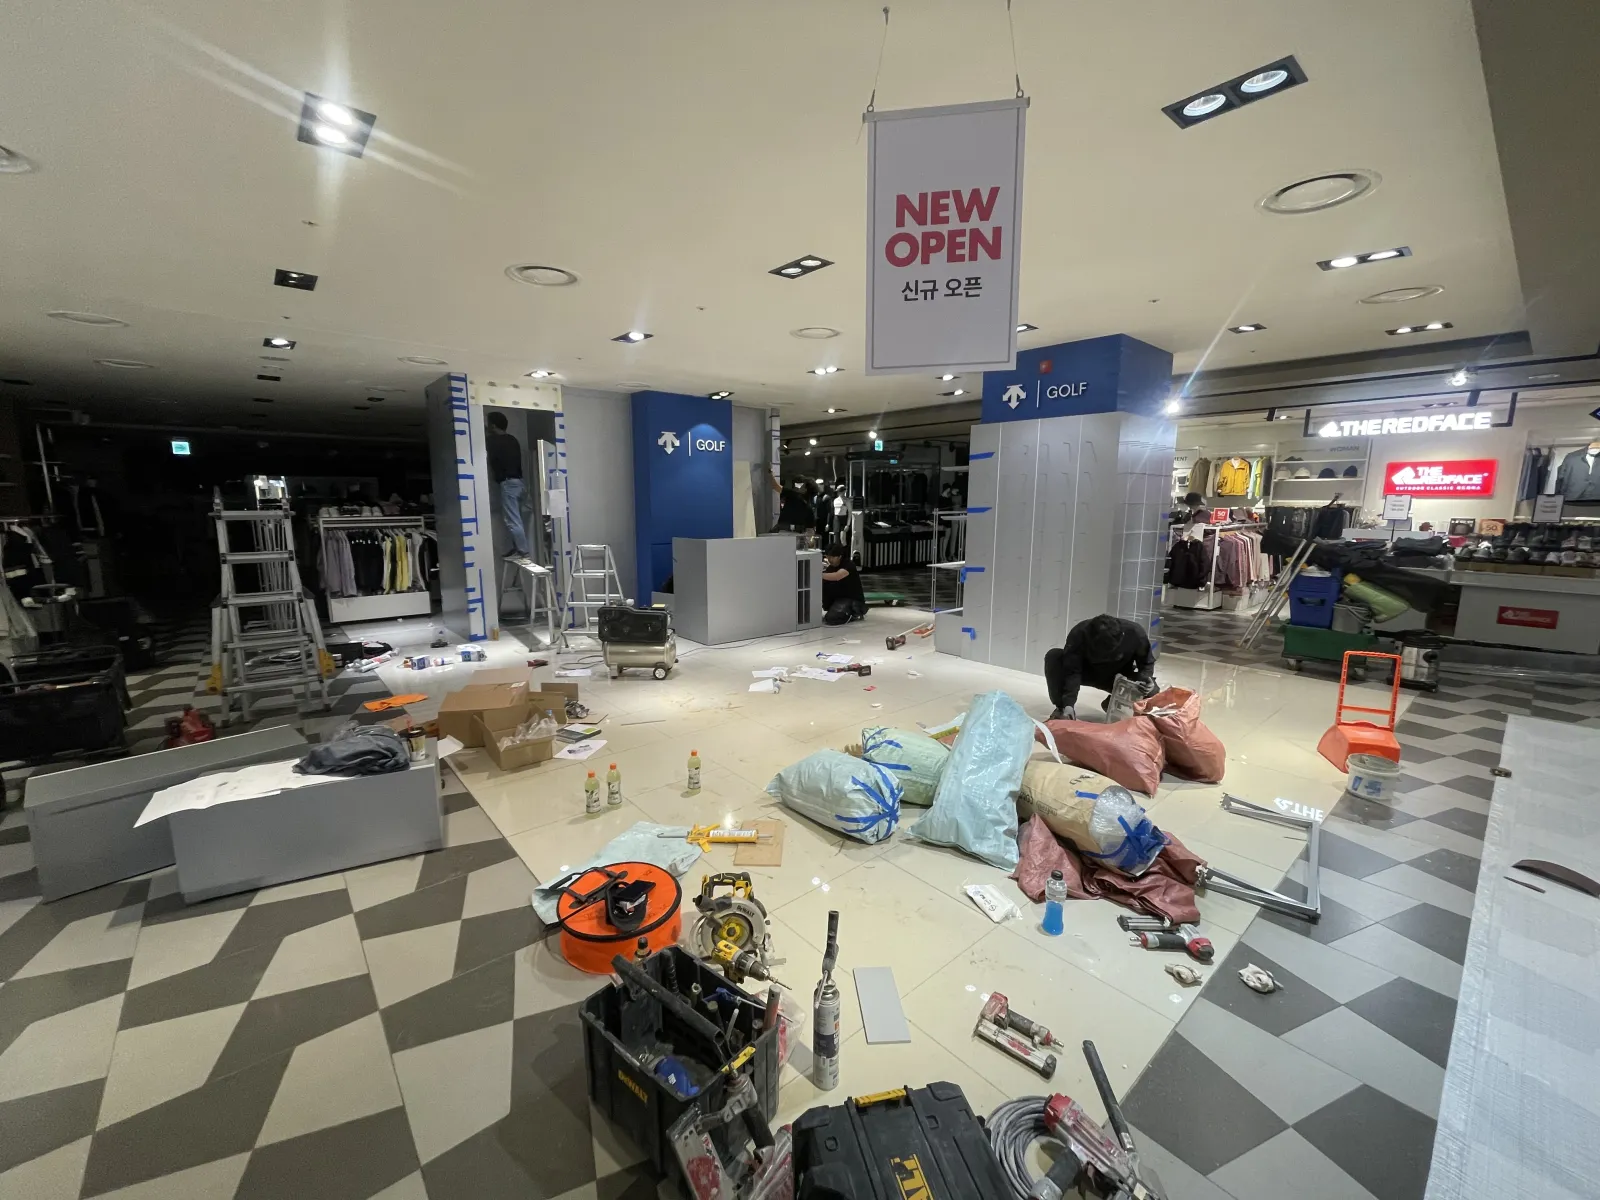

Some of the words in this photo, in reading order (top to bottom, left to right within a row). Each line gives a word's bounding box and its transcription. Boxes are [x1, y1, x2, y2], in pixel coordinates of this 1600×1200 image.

[895, 186, 1001, 228] NEW
[884, 226, 1002, 268] OPEN
[901, 279, 939, 302] 신규
[943, 276, 983, 298] 오픈
[1046, 381, 1088, 399] GOLF
[696, 439, 726, 452] GOLF
[1416, 466, 1444, 476] THE
